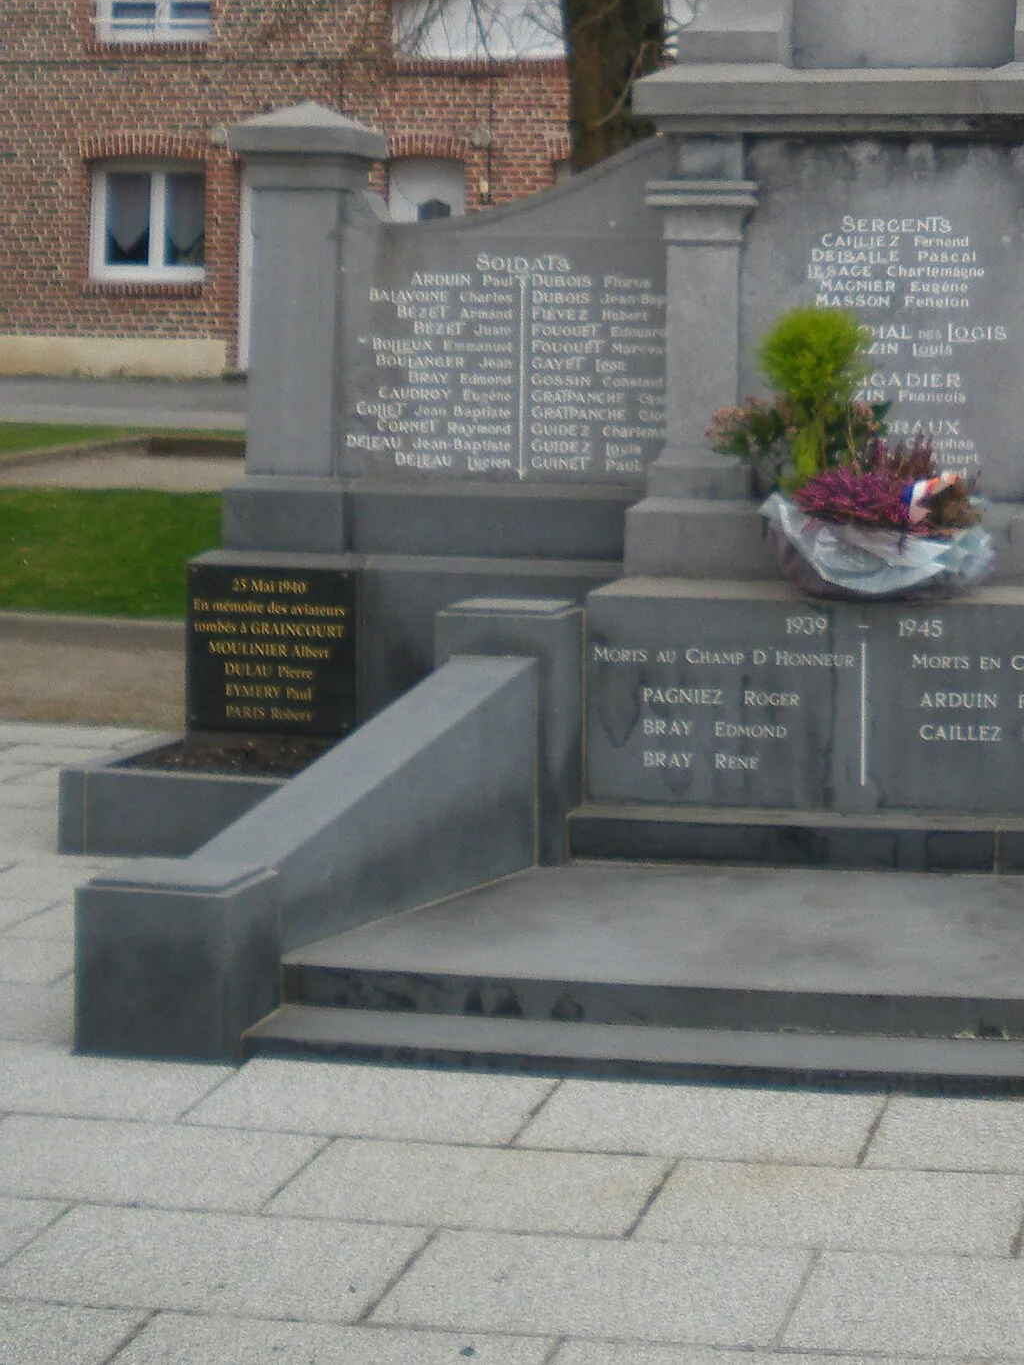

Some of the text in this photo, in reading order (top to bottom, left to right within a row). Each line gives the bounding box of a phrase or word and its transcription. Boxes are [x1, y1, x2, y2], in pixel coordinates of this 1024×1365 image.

[841, 215, 952, 234] SERGENTS
[914, 236, 969, 248] Fernand
[476, 253, 571, 273] SOLDATS
[918, 251, 977, 263] Pascal
[482, 274, 513, 287] Paul
[887, 266, 985, 280] Charlemagne
[820, 281, 896, 293] MAGNIER
[459, 291, 513, 303] Charles
[815, 294, 890, 308] MASSON
[948, 323, 1007, 342] LOGIS
[912, 343, 953, 357] Louis
[860, 372, 961, 387] IGADIER
[378, 385, 451, 401] CAUDROY
[447, 420, 512, 437] Raymond
[531, 439, 591, 454] GUIDEZ
[250, 621, 345, 638] GRAINCOURT
[785, 615, 943, 638] 1939 1945
[656, 650, 676, 663] AU
[686, 647, 745, 665] CHAMP
[912, 654, 970, 670] MORTS
[980, 657, 1000, 670] EN
[643, 687, 800, 707] PAGNIEZ ROGER
[920, 692, 997, 710] ARDUIN
[643, 718, 788, 738] BRAY EDMOND
[919, 724, 1002, 741] CAILLEZ
[643, 751, 692, 769] BRAY
